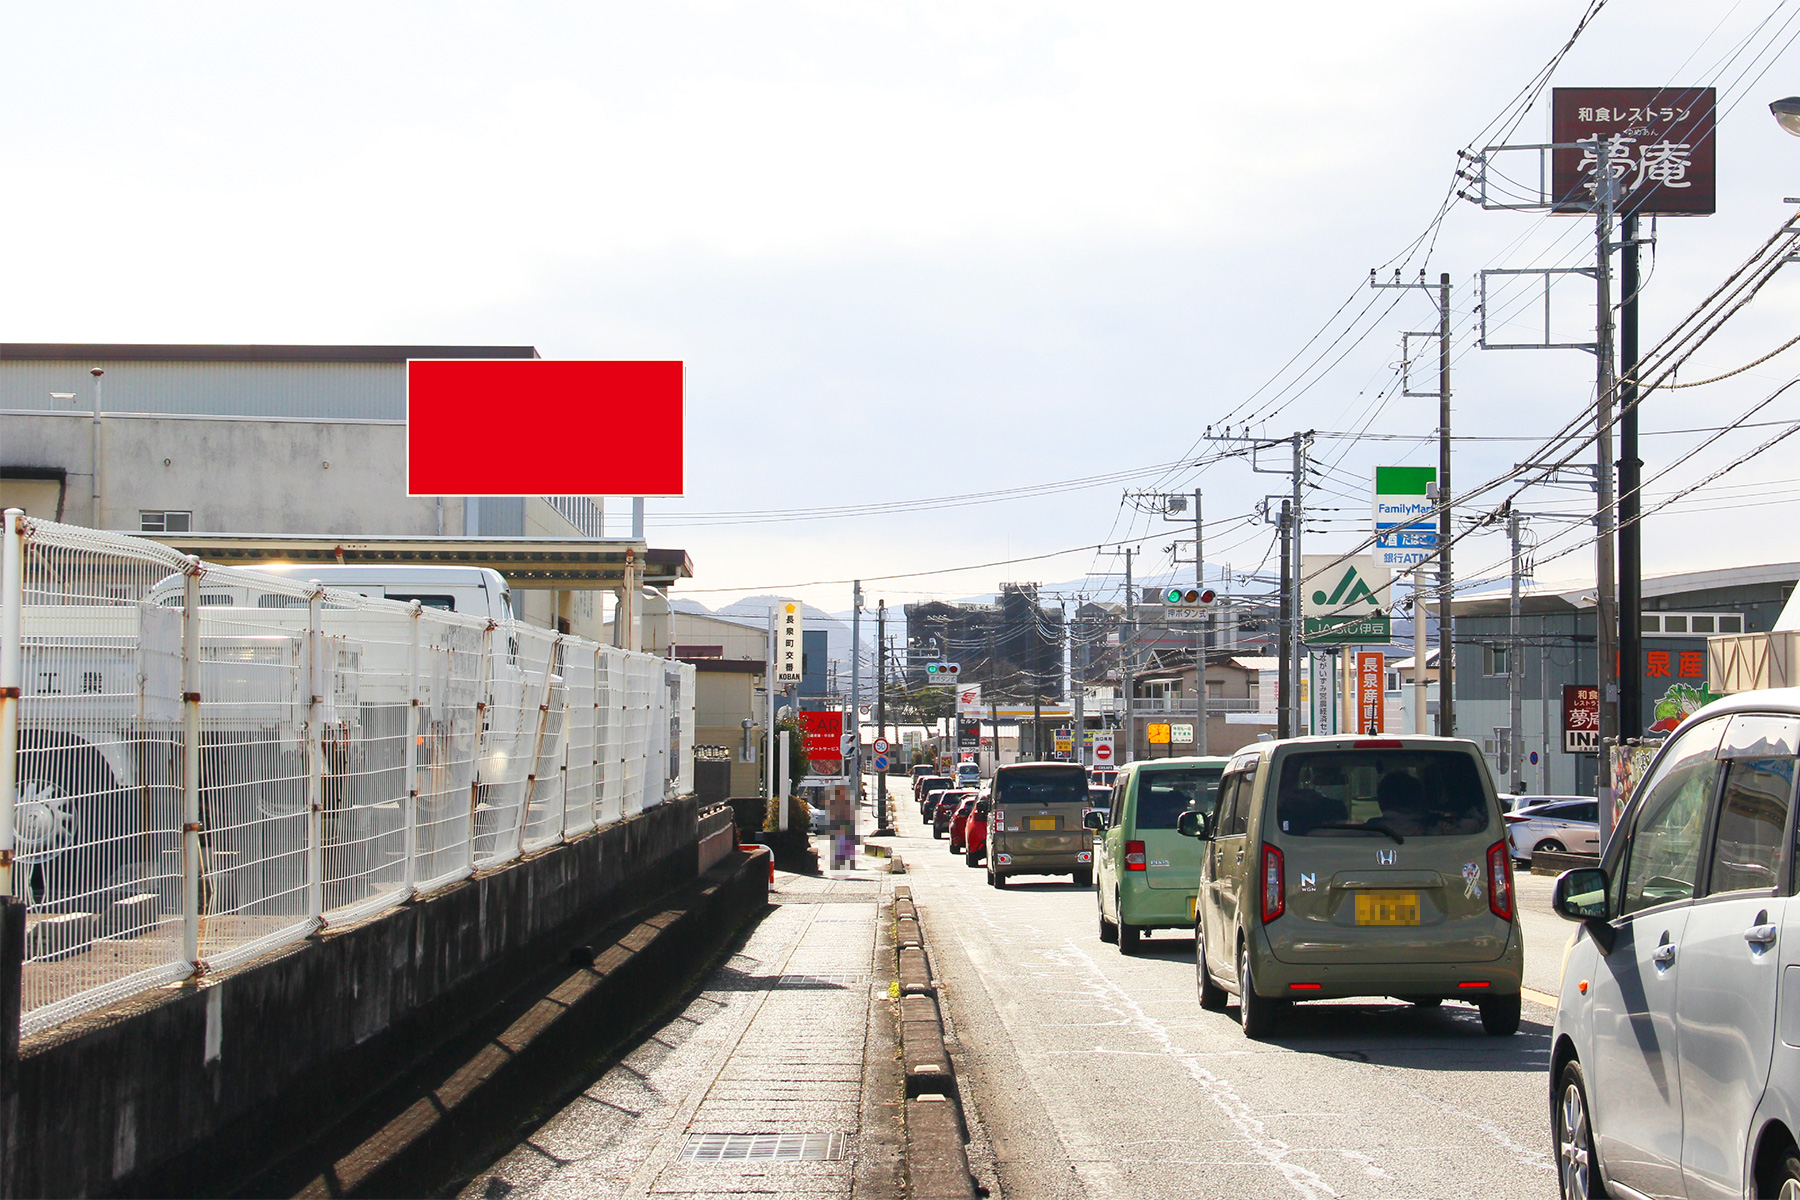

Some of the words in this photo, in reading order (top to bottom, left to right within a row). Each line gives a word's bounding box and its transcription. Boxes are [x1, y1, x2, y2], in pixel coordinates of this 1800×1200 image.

[1578, 107, 1690, 122] 和食レストラン
[1167, 607, 1209, 620] 押ボタン式
[785, 615, 794, 672] 長泉町交番
[779, 673, 800, 681] KOBAN
[930, 676, 957, 684] 押ボタン式
[1578, 690, 1599, 700] 和食
[804, 718, 840, 733] CAR
[876, 742, 886, 751] 50
[1300, 872, 1316, 887] N
